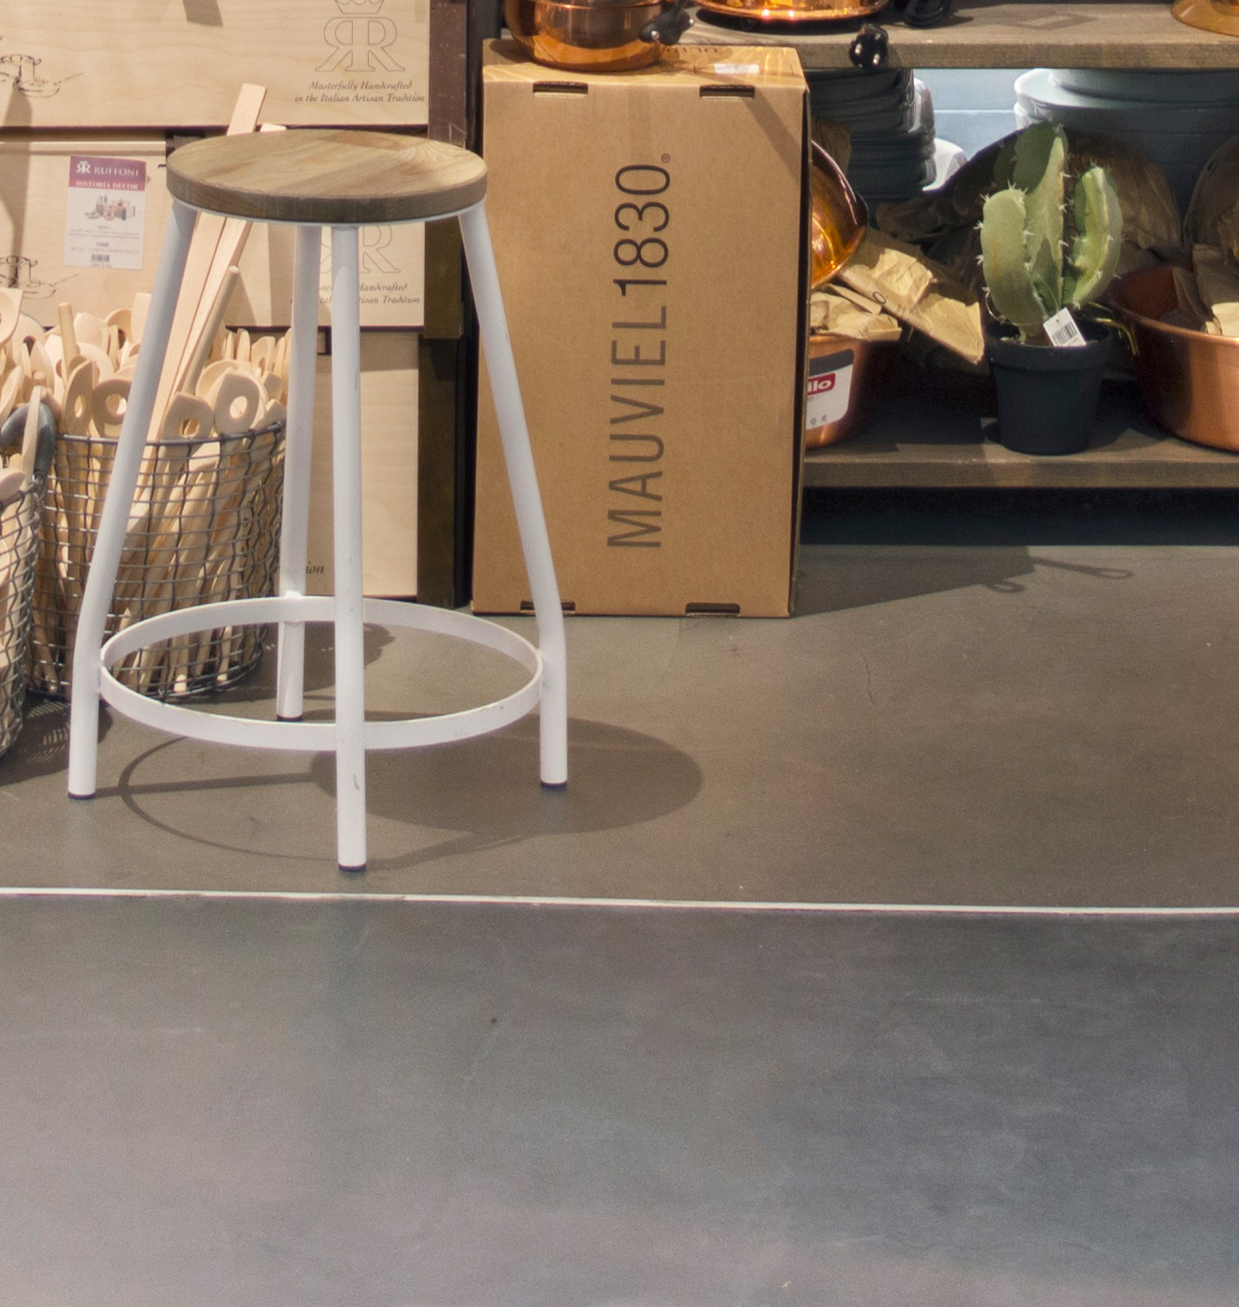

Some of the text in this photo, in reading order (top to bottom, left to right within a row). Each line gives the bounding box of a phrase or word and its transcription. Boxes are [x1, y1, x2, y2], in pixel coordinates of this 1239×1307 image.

[305, 93, 318, 102] the
[320, 93, 350, 102] Italian
[352, 93, 384, 102] Artisan
[387, 93, 425, 102] Tradition
[94, 166, 139, 177] RUFFONI
[75, 180, 110, 188] HISTORIA
[606, 164, 670, 548] MAUVIEL1830
